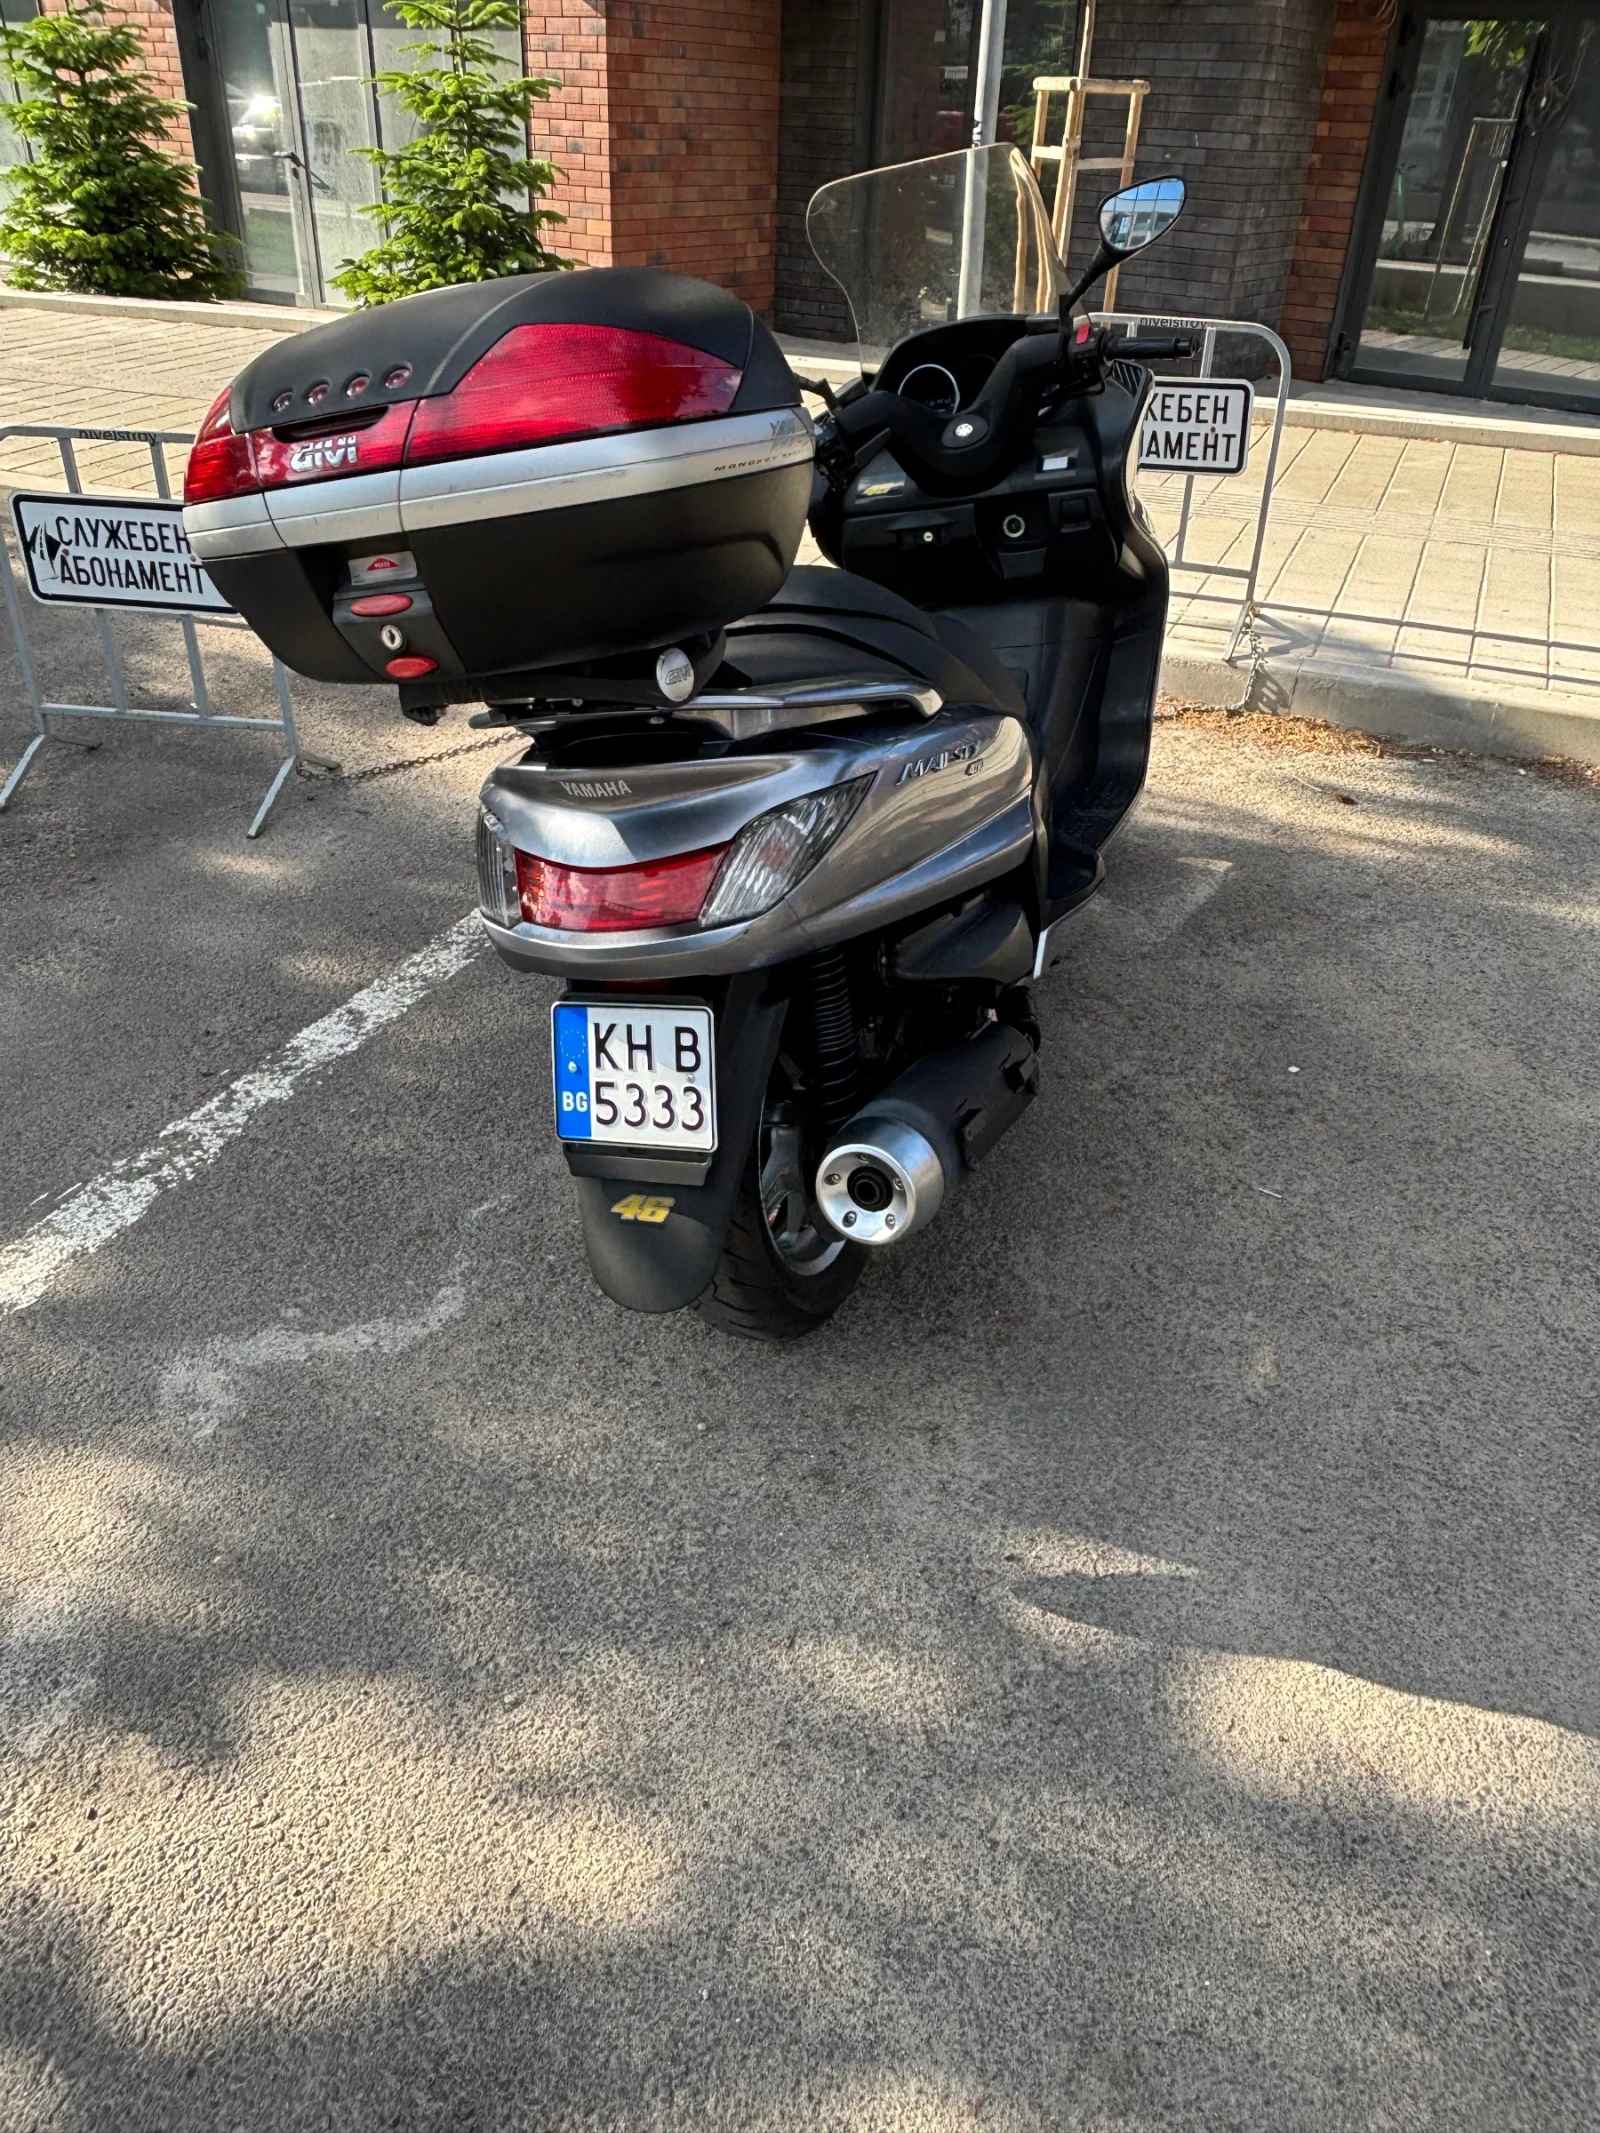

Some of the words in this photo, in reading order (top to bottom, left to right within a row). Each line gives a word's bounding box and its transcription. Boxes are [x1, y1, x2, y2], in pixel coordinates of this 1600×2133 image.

[290, 435, 358, 473] GIVI
[1140, 430, 1237, 462] АМЕНТ
[55, 515, 192, 555] СЛУЖЕБЕН
[59, 553, 204, 595] АБОНАМЕНТ
[559, 779, 633, 798] YAMAHA
[561, 1091, 588, 1113] BG
[594, 1080, 705, 1132] 5333
[610, 1193, 676, 1223] 46
